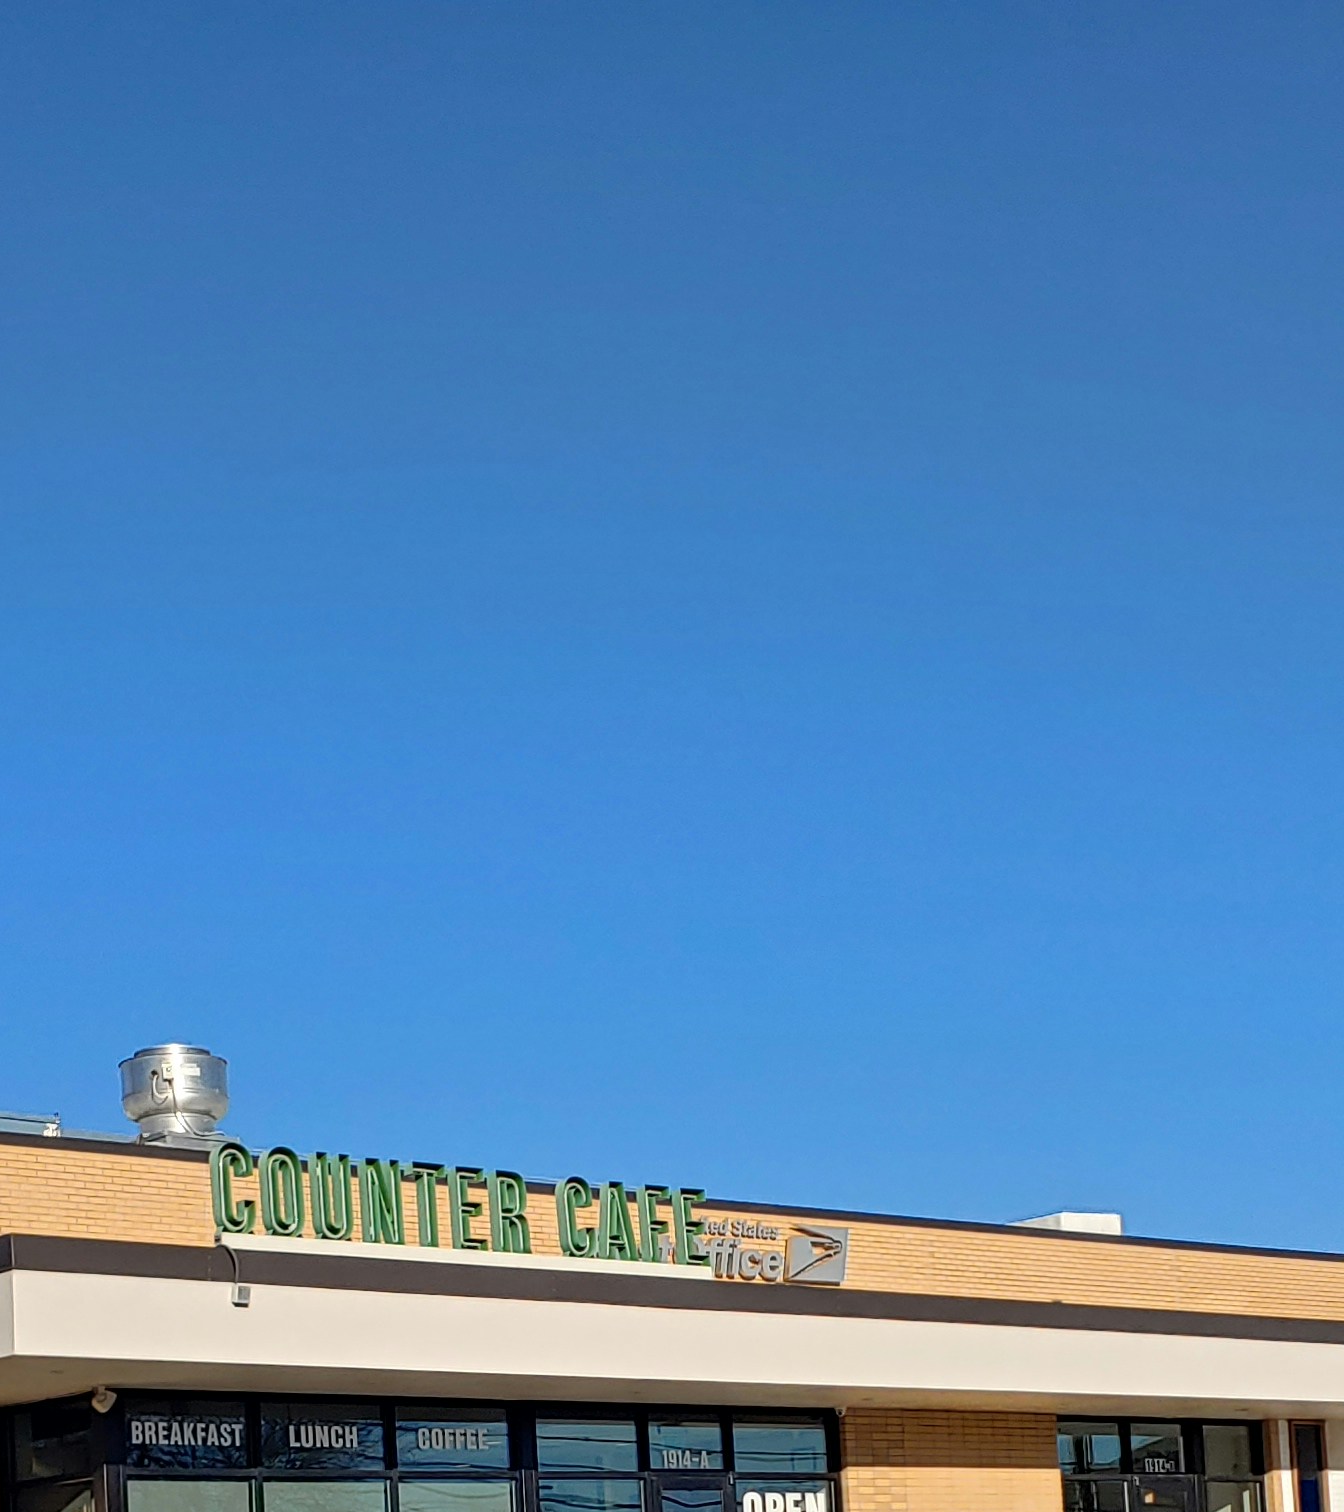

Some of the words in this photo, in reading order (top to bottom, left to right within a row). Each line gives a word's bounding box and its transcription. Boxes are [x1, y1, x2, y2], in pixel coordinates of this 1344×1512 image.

[209, 1142, 531, 1254] COUNTER
[554, 1176, 710, 1266] CAFE
[131, 1421, 244, 1448] BREAKFAST
[288, 1424, 358, 1448] LUNCH
[417, 1427, 489, 1450] COFFEE
[662, 1450, 709, 1469] 1914-A
